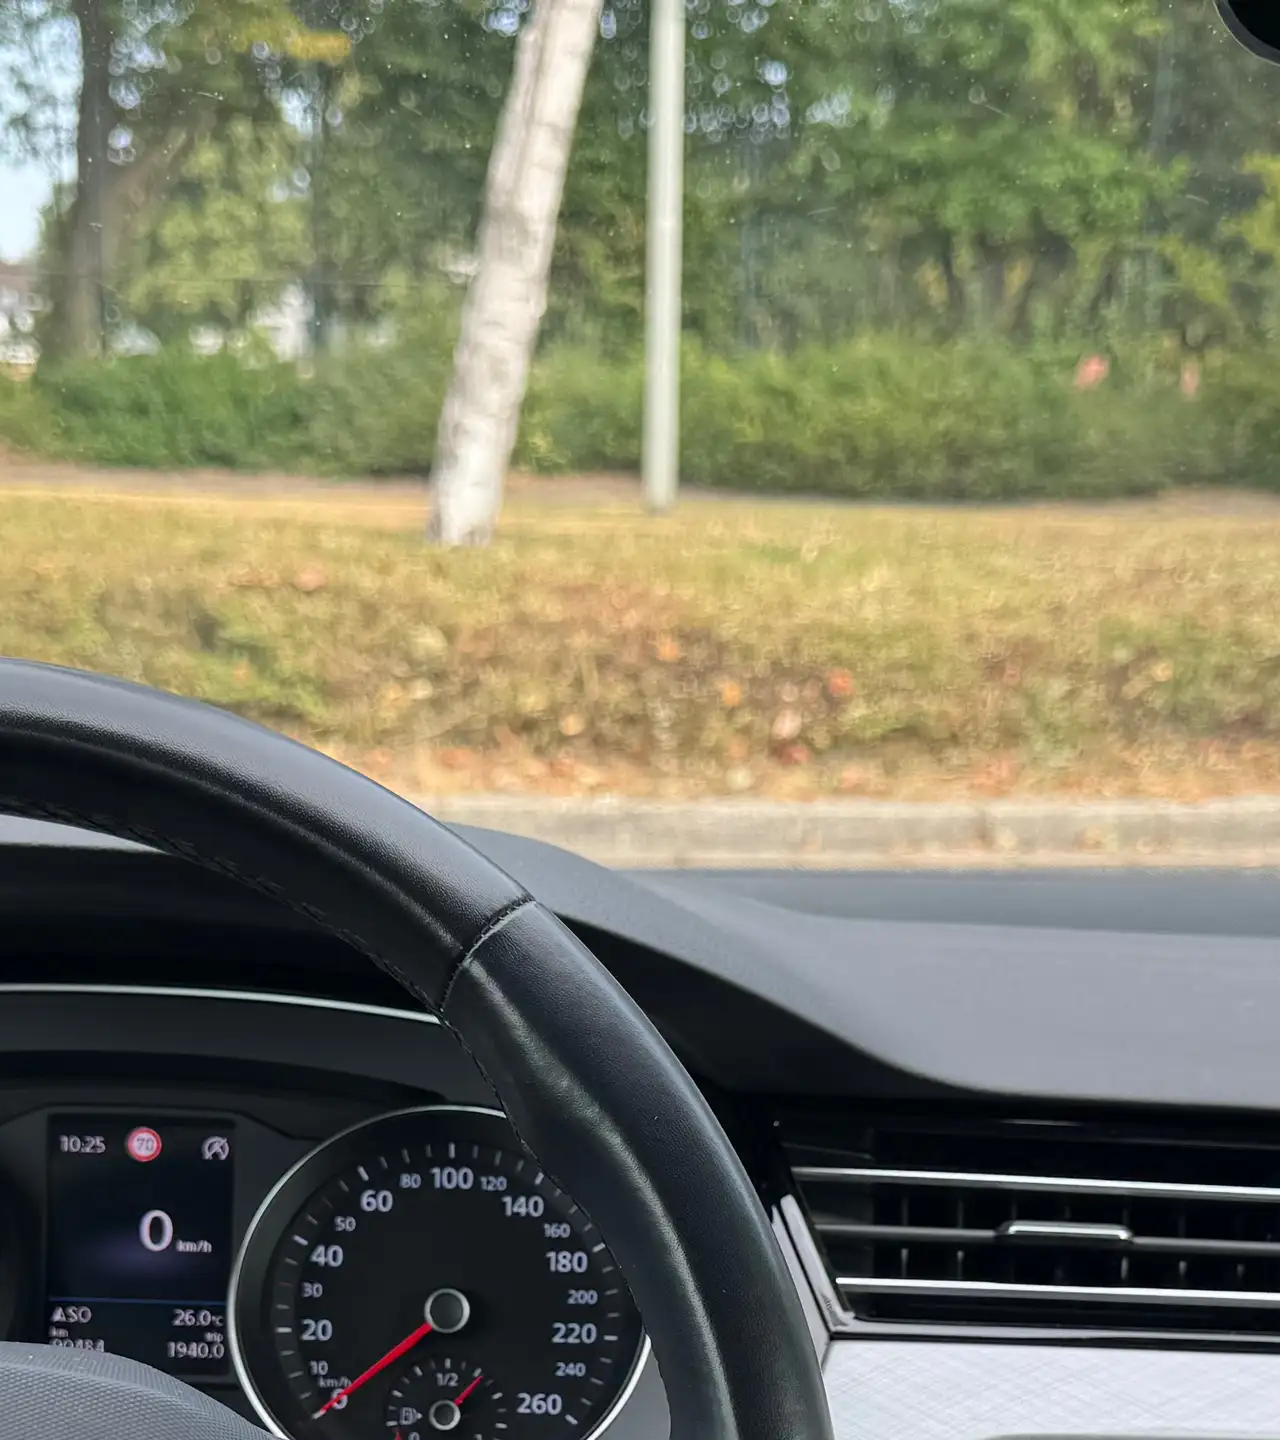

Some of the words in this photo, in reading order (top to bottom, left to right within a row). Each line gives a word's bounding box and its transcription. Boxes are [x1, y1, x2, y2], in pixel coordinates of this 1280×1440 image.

[135, 1136, 155, 1151] 70
[400, 1173, 421, 1189] 80
[431, 1168, 474, 1189] 100
[480, 1176, 507, 1191] 120
[361, 1190, 393, 1212] 60
[502, 1196, 544, 1218] 140
[139, 1209, 174, 1252] 0
[176, 1239, 213, 1253] km/h
[335, 1216, 356, 1232] 50
[544, 1223, 571, 1239] 160
[310, 1244, 343, 1267] 40
[546, 1251, 588, 1273] 180
[303, 1283, 323, 1298] 30
[568, 1290, 598, 1305] 200
[301, 1319, 332, 1341] 20
[552, 1322, 597, 1344] 220
[167, 1341, 225, 1358] 1940.0
[310, 1360, 329, 1375] 10
[556, 1362, 586, 1378] 240
[436, 1372, 458, 1387] 1/2
[516, 1392, 563, 1415] 260
